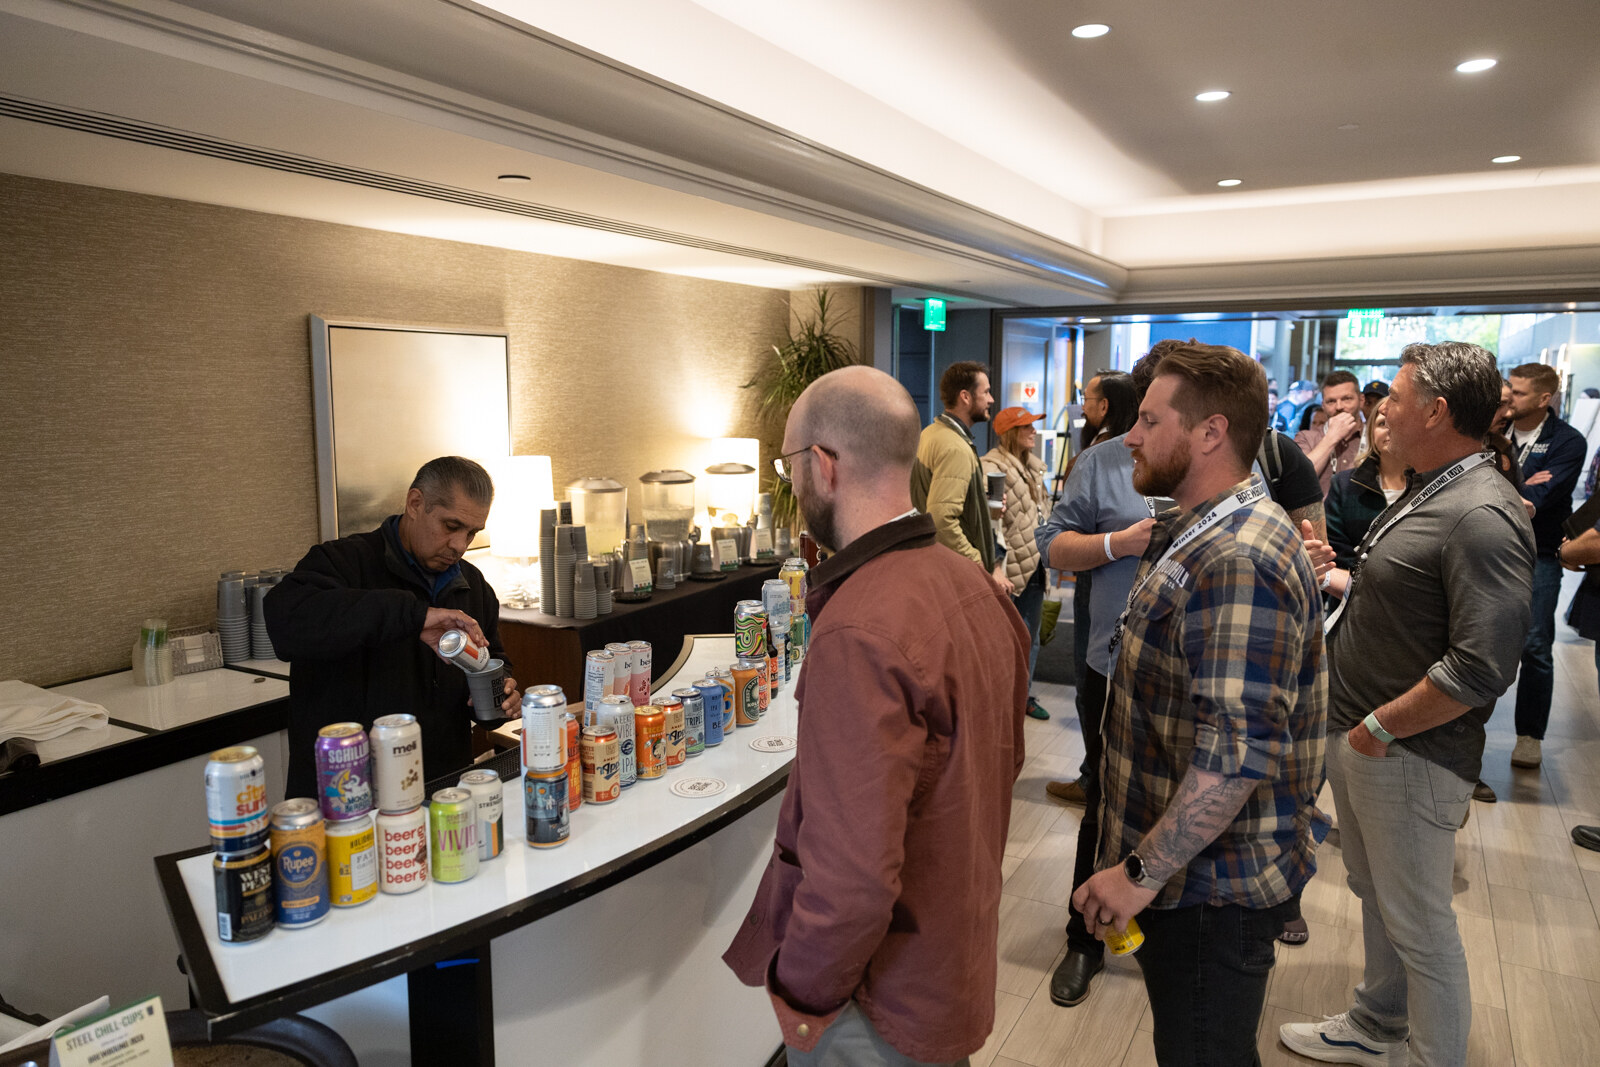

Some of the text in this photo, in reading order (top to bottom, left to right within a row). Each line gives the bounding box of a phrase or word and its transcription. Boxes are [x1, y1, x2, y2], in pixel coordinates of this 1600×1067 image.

[1411, 464, 1464, 507] BREWBOUND LIVE
[1172, 511, 1217, 548] Winter 2024
[393, 741, 417, 755] meli
[438, 824, 478, 852] VIVID
[240, 862, 271, 882] WEST
[282, 856, 314, 873] Rupee
[65, 1033, 93, 1052] STEEL
